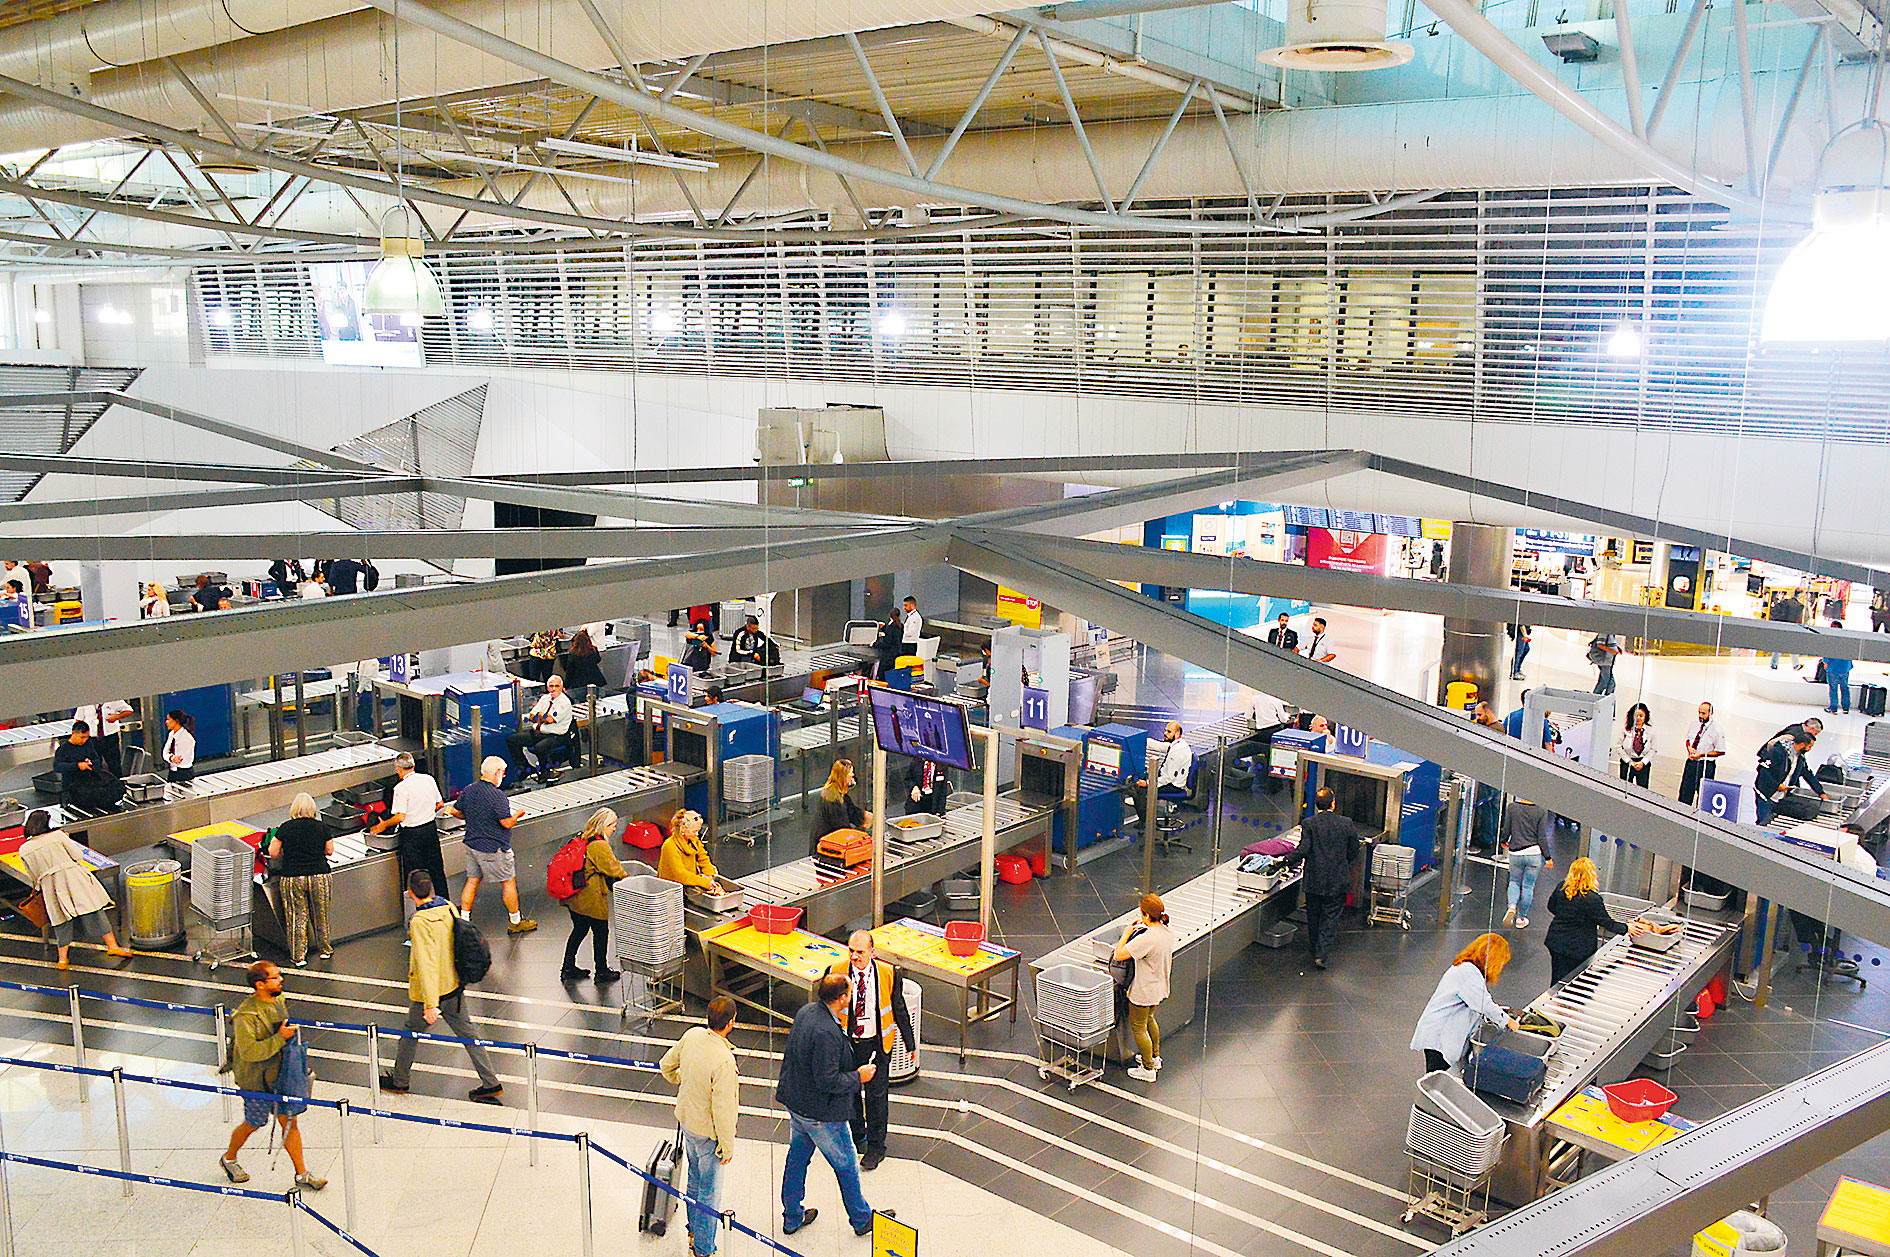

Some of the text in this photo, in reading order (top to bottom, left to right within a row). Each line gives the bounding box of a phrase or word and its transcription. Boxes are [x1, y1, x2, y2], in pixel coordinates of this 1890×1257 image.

[19, 602, 29, 619] 15
[392, 654, 404, 674] 13
[671, 673, 686, 695] 12
[1027, 697, 1044, 720] 11
[1341, 726, 1363, 747] 10
[1712, 794, 1727, 817] 9
